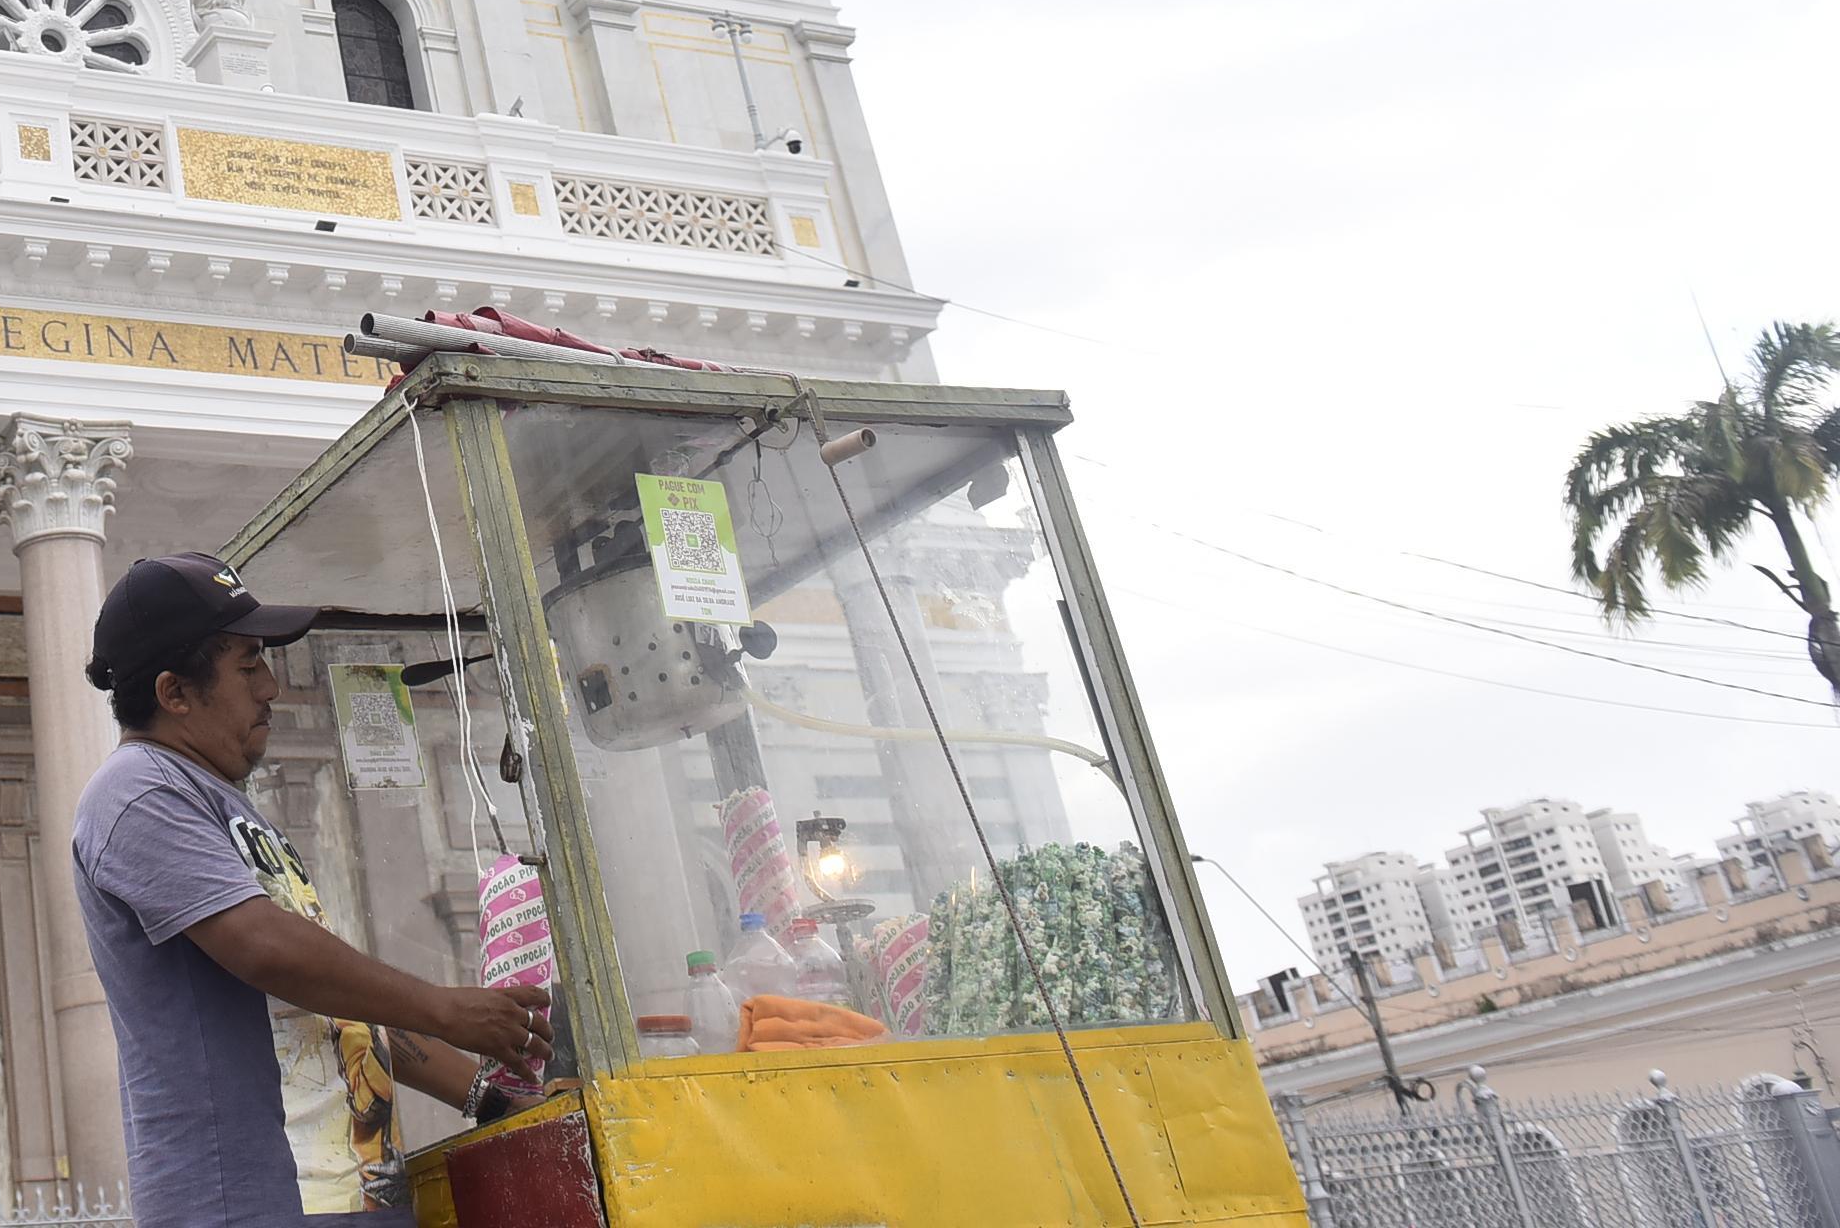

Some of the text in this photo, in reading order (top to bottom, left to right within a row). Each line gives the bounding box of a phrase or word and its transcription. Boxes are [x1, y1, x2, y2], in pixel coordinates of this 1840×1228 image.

[658, 479, 705, 495] PAGUE COM
[682, 496, 699, 509] PIX
[513, 942, 547, 968] PIPOCÃO
